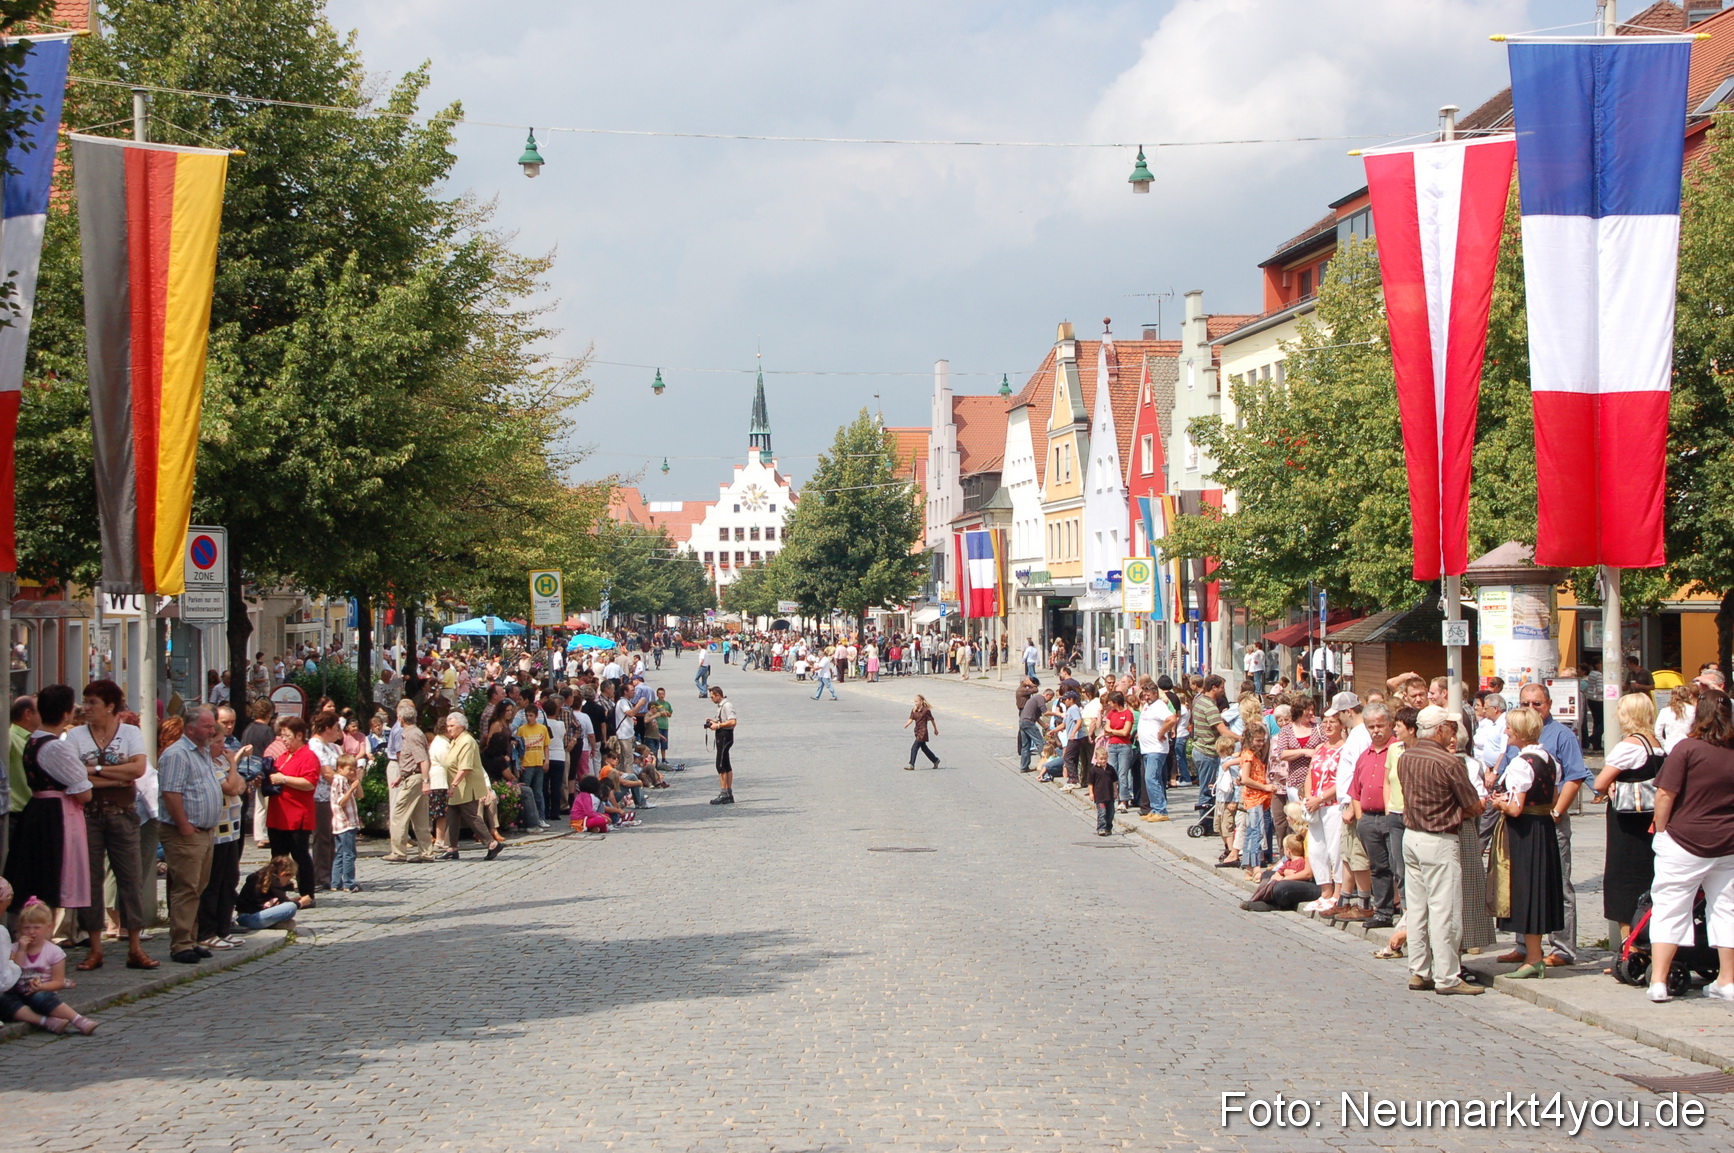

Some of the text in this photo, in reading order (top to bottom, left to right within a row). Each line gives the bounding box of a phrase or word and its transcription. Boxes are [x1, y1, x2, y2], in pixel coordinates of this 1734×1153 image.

[194, 572, 215, 581] ZONE
[541, 579, 552, 592] H
[349, 603, 354, 624] P
